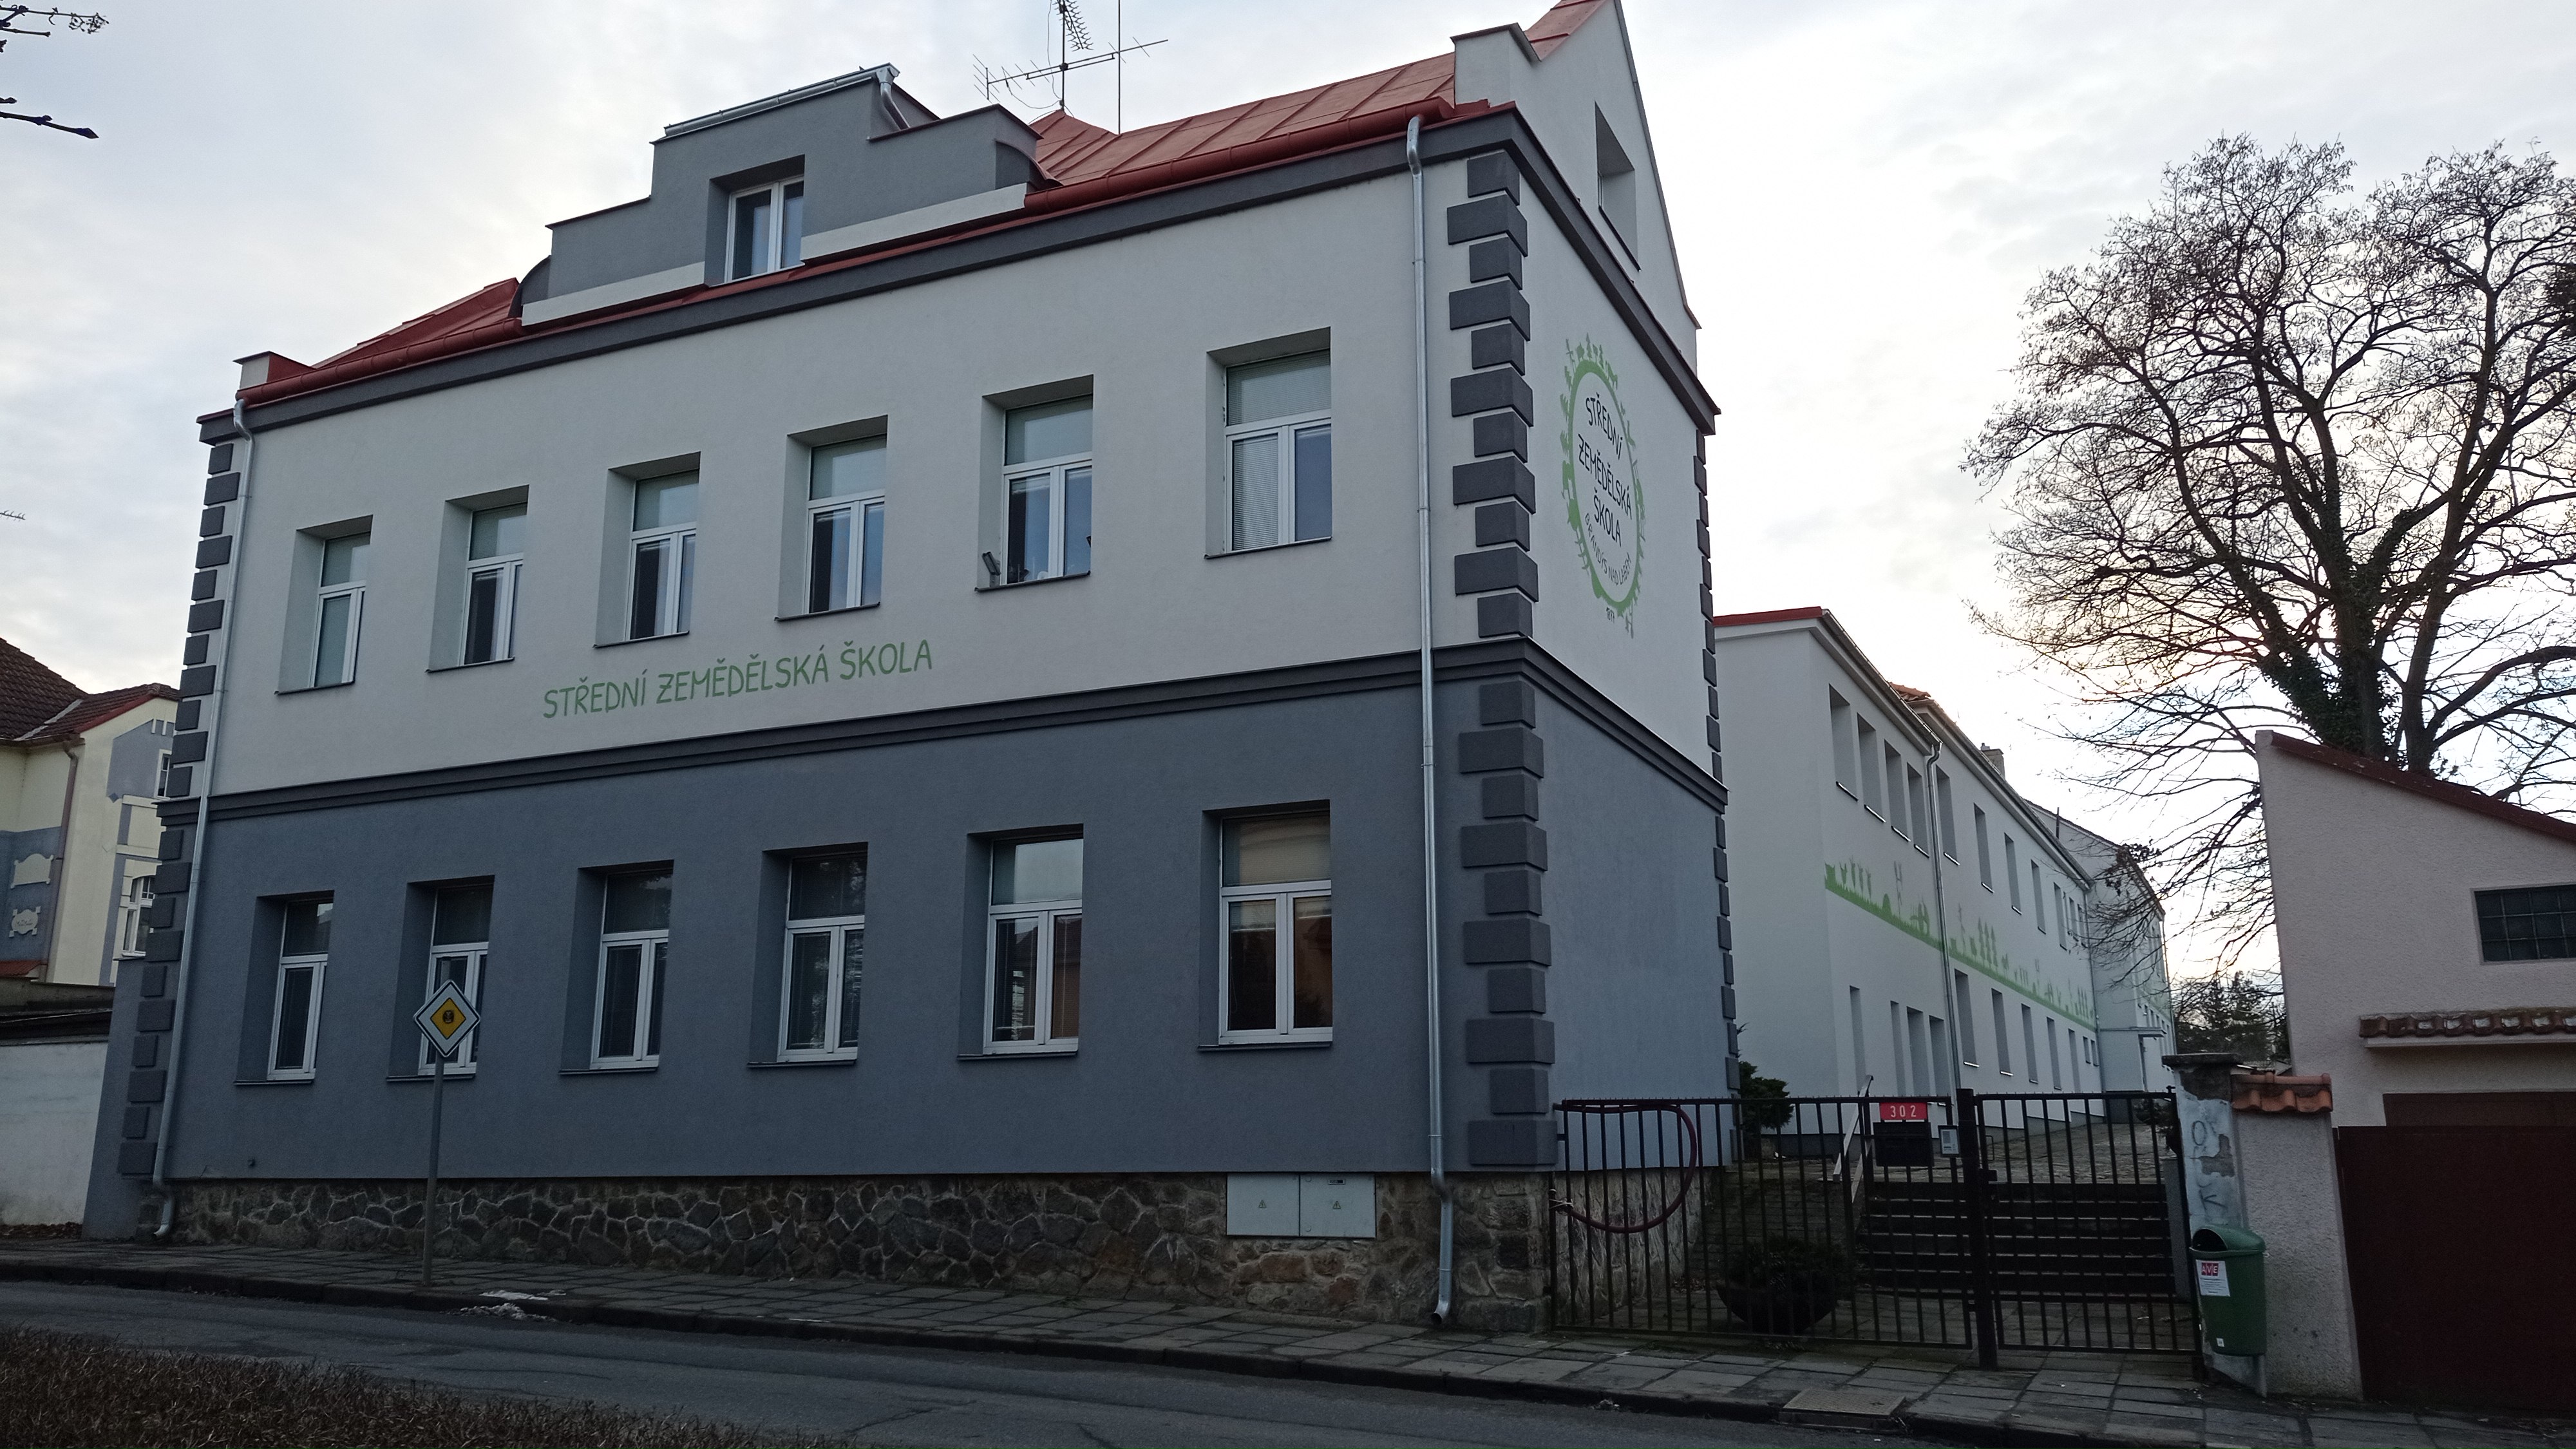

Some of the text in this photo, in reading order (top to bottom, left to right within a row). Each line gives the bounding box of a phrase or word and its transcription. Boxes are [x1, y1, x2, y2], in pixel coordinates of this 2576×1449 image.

[1586, 392, 1623, 460] STŘEDNÍ
[1578, 433, 1632, 520] ZEMĚDĚLSKÁ
[1585, 513, 1607, 574] BRANDÝS
[1608, 565, 1619, 586] NAD
[1593, 487, 1622, 547] ŠKOLA
[543, 639, 933, 719] STŘEDNÍ ZEMĚDĚLSKÁ ŠKOLA
[1889, 1104, 1917, 1117] 302
[2201, 1264, 2219, 1274] AVE
